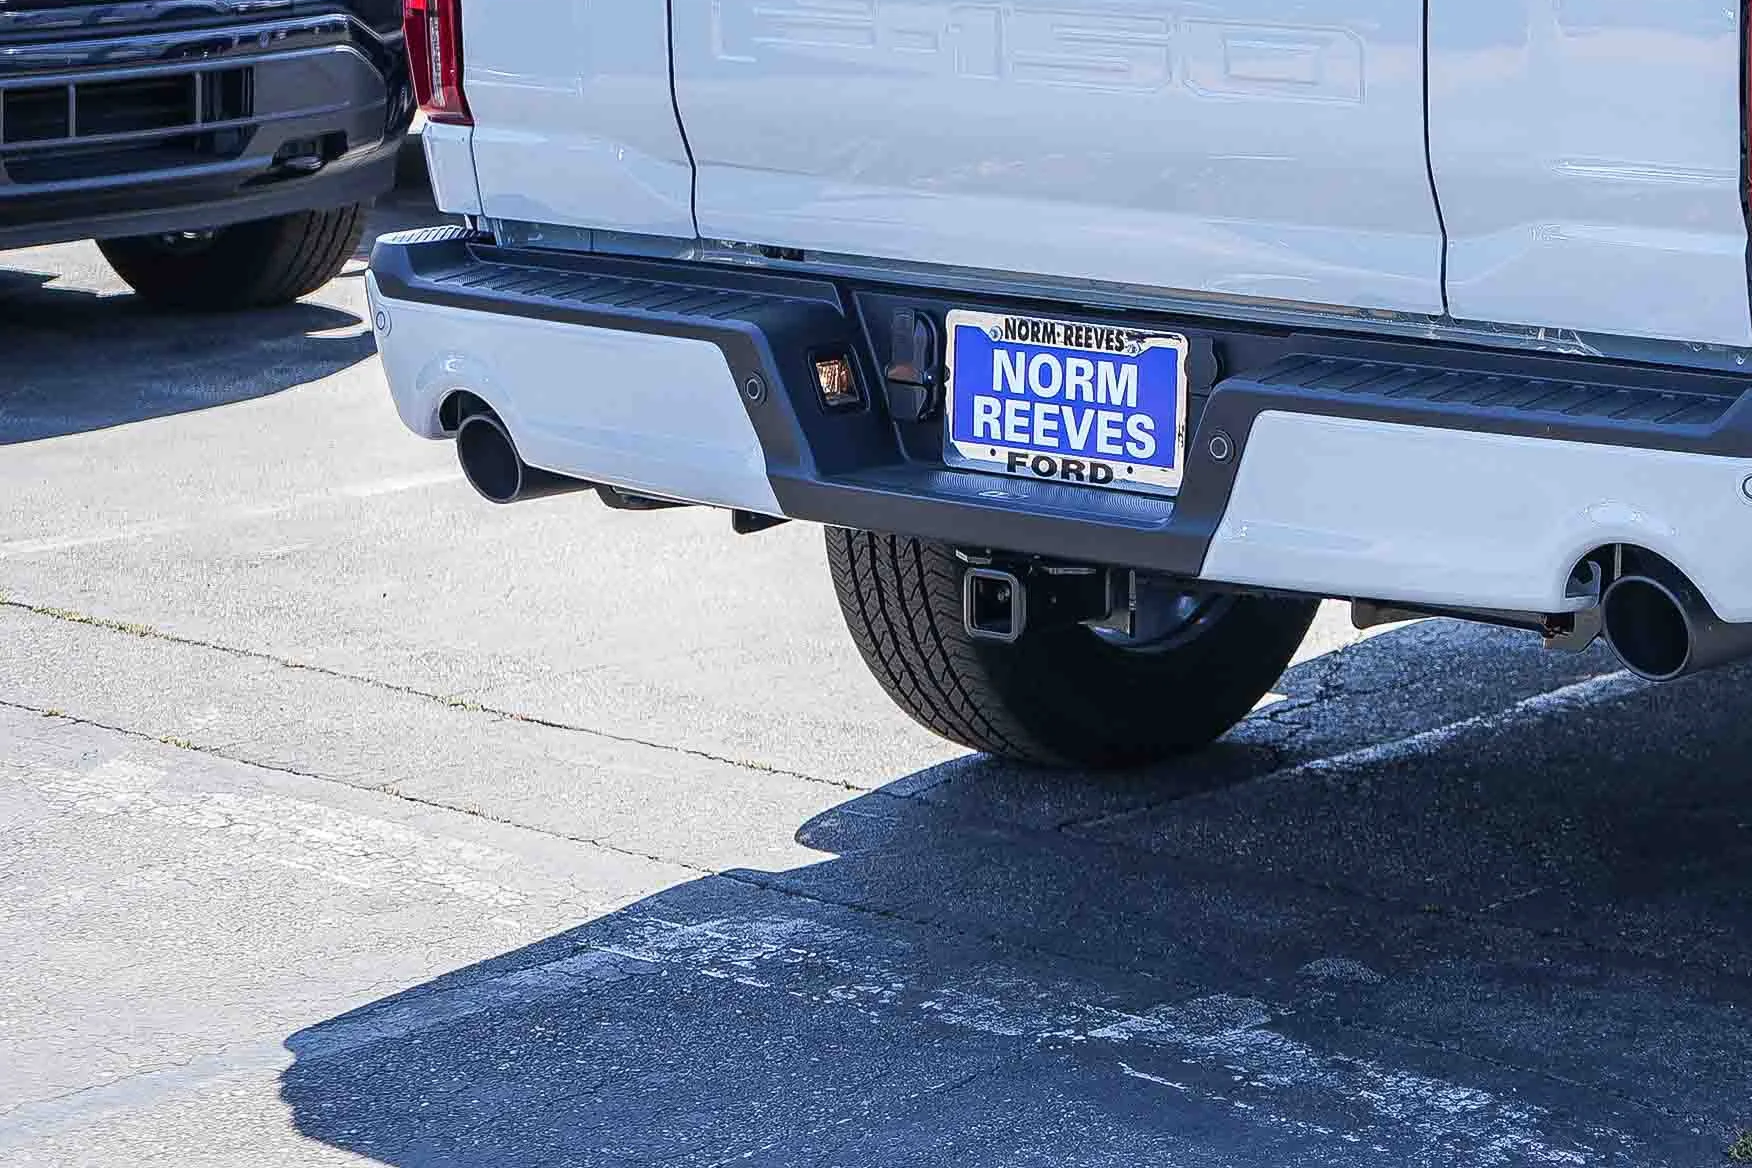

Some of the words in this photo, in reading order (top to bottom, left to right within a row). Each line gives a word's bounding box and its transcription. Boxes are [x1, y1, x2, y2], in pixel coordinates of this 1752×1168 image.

[1004, 316, 1057, 345] NORM
[1063, 323, 1126, 352] REEVES
[992, 348, 1138, 407] NORM
[973, 394, 1157, 459] REEVES
[1006, 451, 1114, 485] FORD
